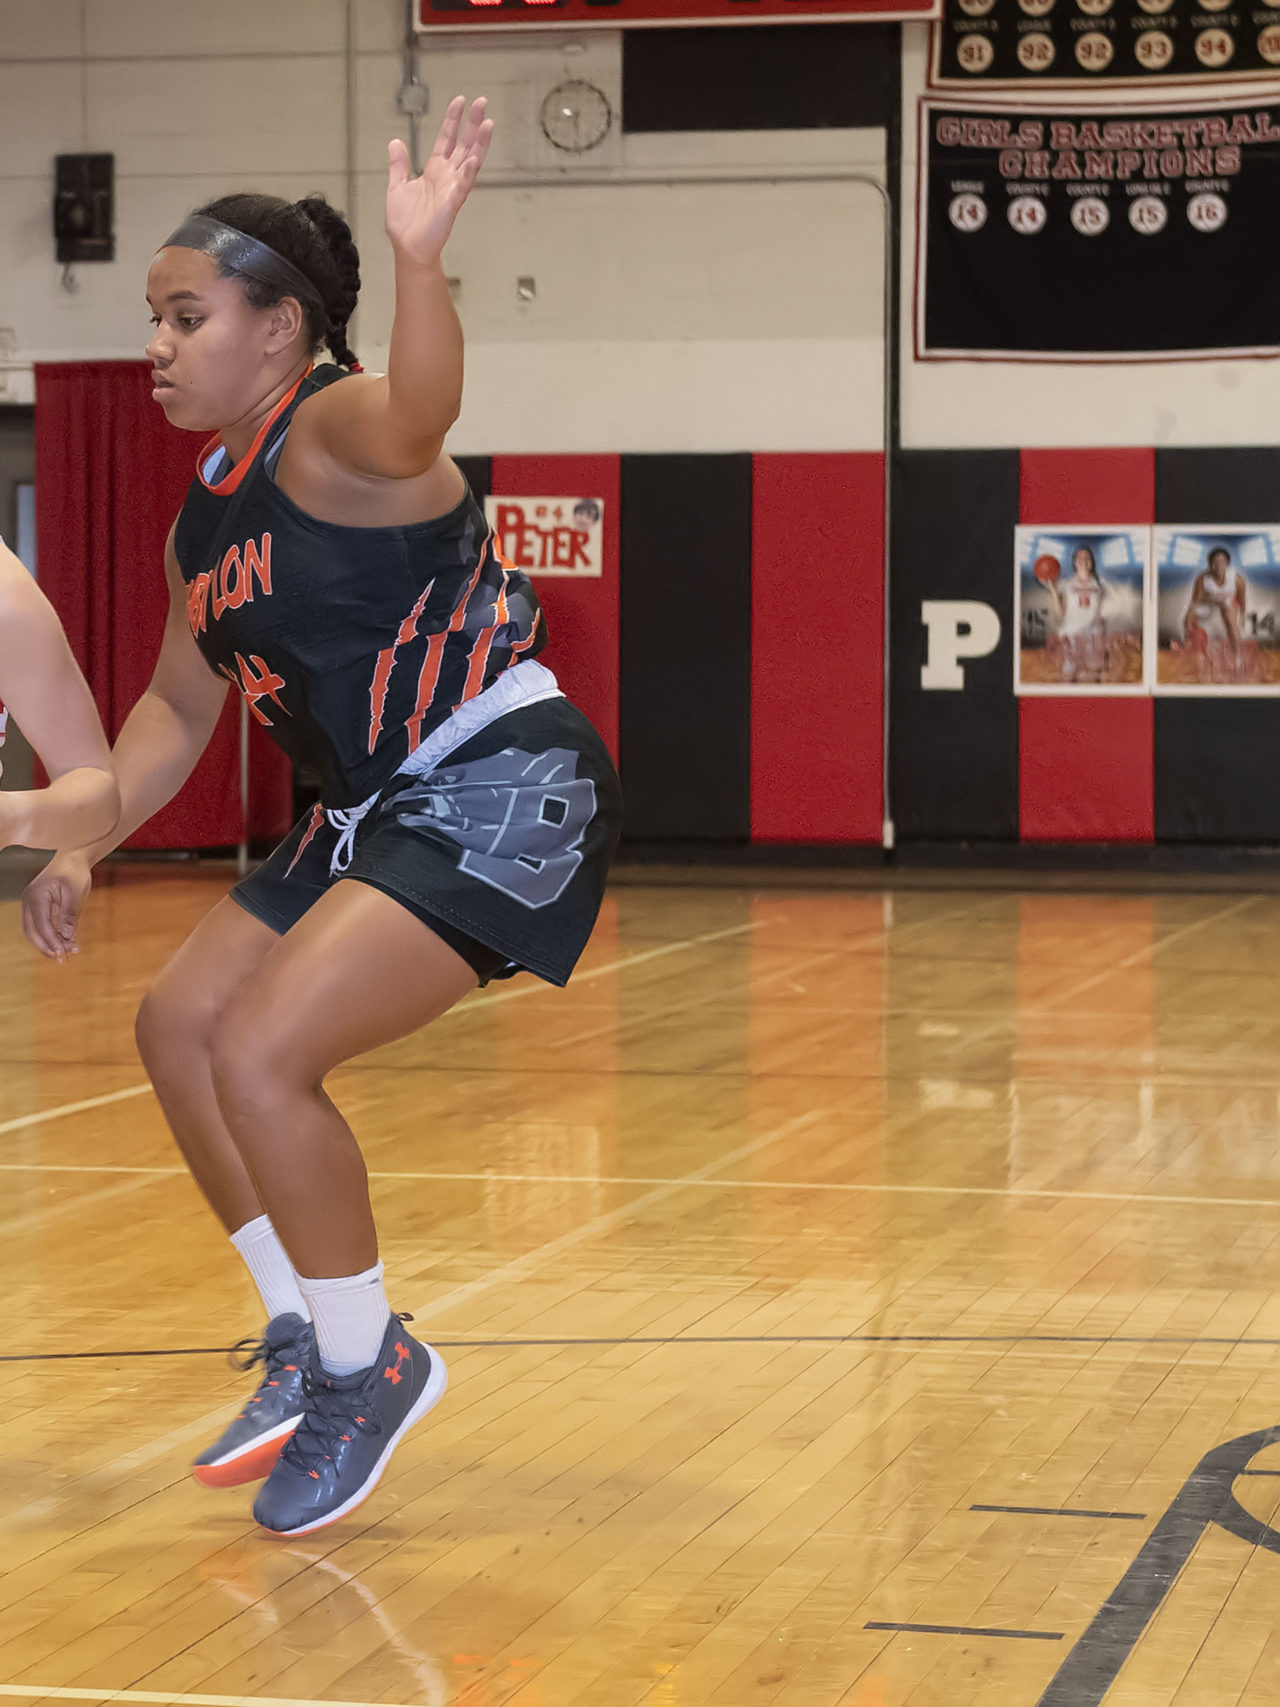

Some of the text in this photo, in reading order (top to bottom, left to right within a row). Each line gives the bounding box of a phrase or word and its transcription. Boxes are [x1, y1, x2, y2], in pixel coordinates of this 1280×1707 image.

[936, 117, 1043, 149] GIRLS
[998, 145, 1241, 180] CHAMPIONS
[496, 504, 591, 569] PETER
[920, 600, 1002, 690] P
